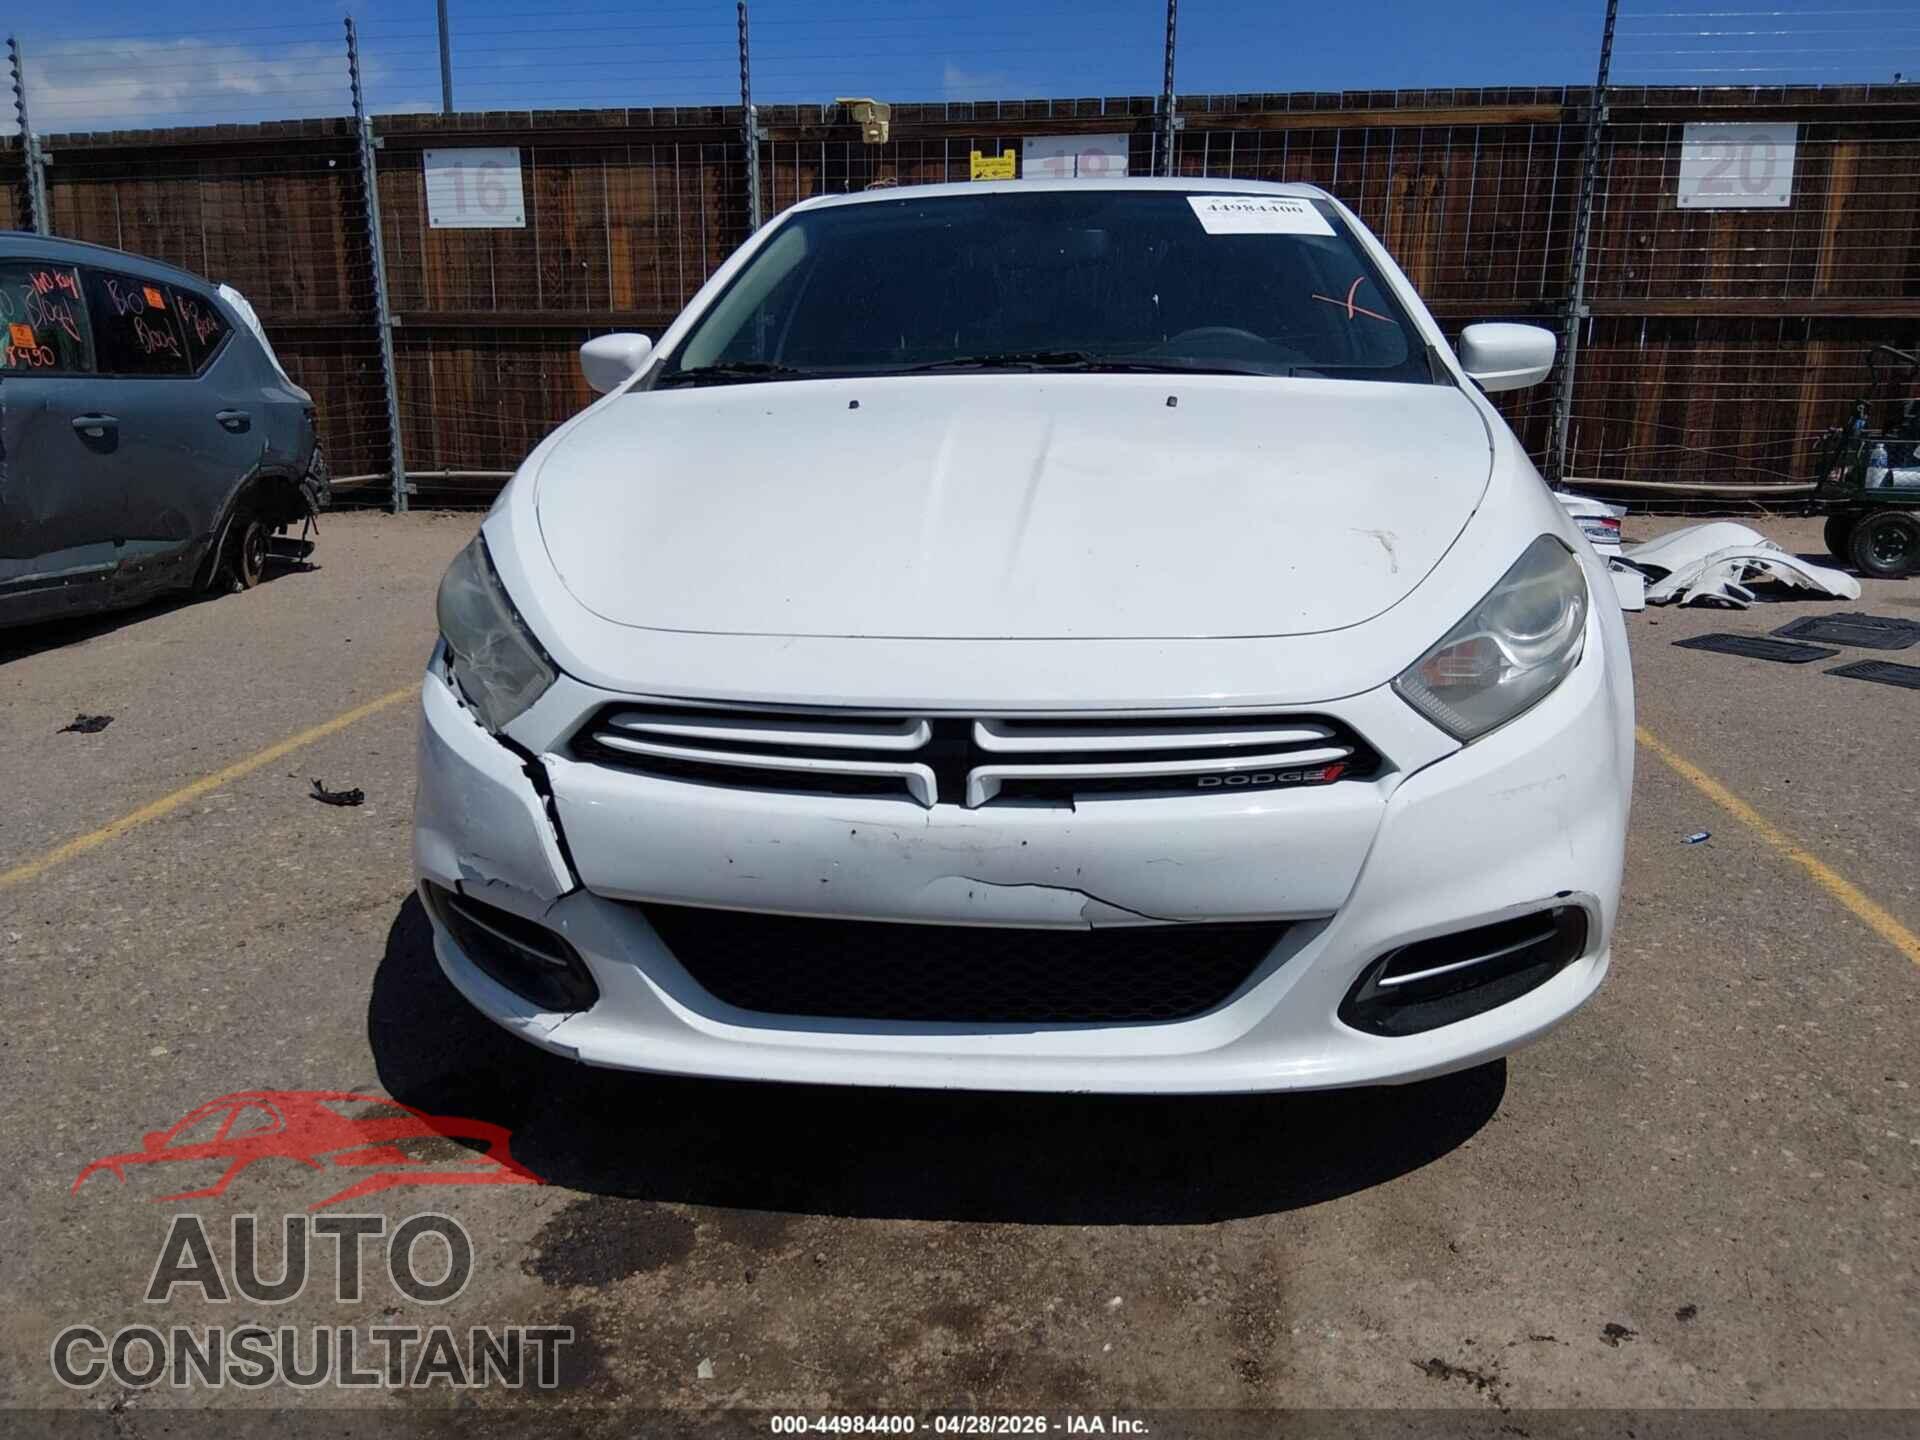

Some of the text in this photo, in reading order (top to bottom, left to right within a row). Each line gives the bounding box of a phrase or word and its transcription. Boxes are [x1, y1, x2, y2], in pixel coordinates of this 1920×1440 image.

[445, 161, 508, 215] 16
[1697, 134, 1776, 194] 20
[1197, 767, 1326, 787] DODGE
